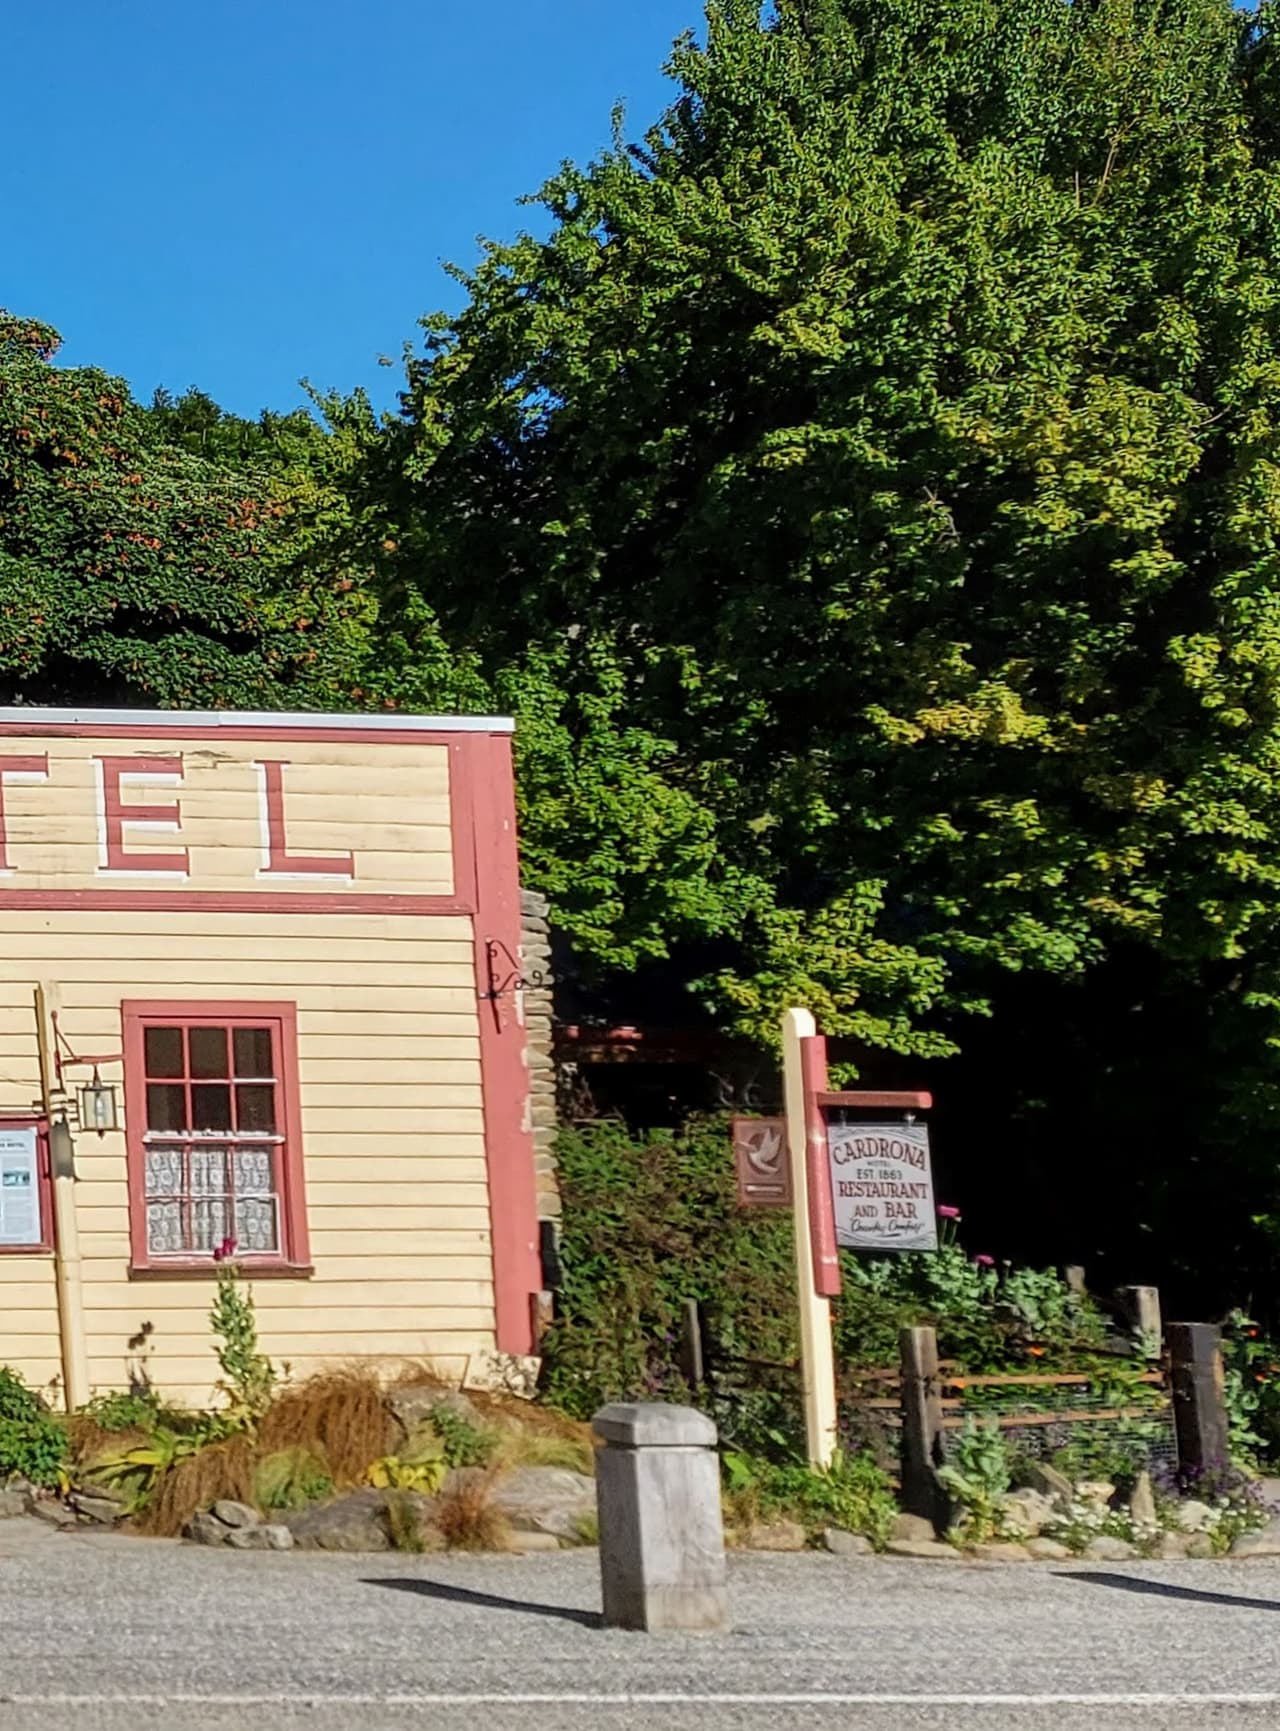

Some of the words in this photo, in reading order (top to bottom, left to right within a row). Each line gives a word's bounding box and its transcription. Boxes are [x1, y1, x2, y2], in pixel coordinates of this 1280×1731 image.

[833, 1136, 928, 1171] CARDRONA
[856, 1168, 875, 1180] EST
[838, 1180, 928, 1200] RESTAURANT
[853, 1204, 879, 1218] AND
[884, 1201, 918, 1219] BAR
